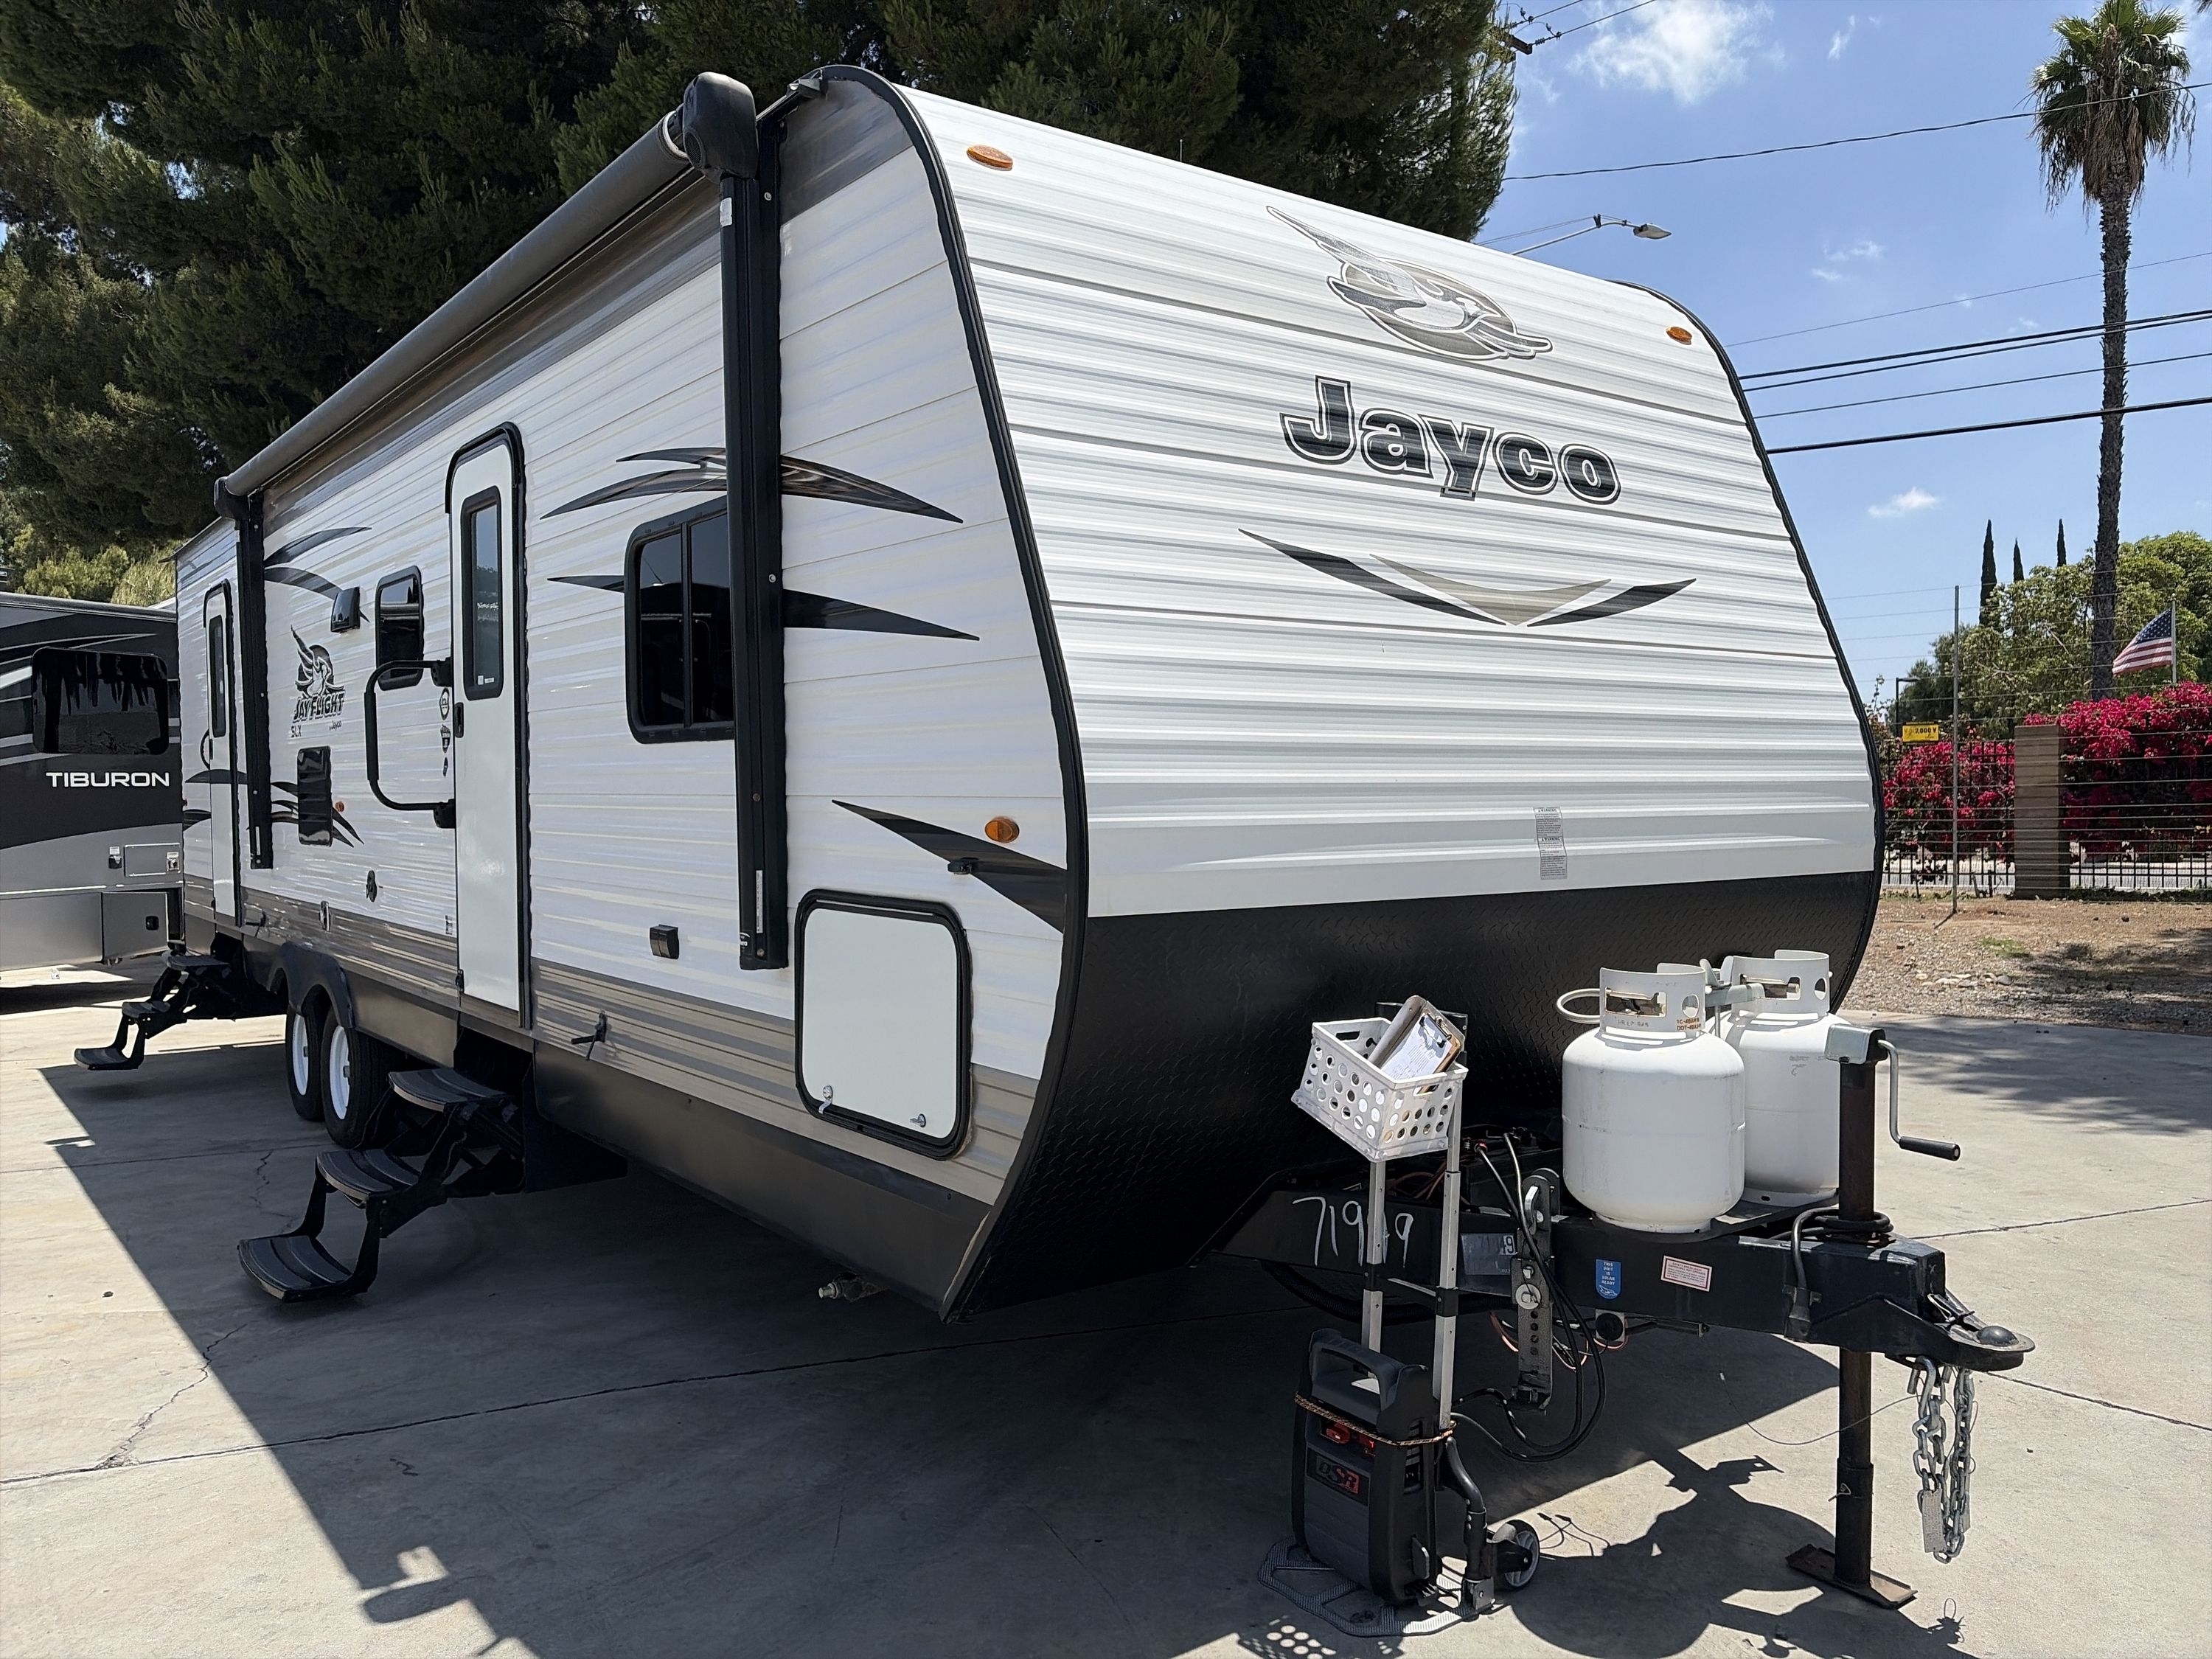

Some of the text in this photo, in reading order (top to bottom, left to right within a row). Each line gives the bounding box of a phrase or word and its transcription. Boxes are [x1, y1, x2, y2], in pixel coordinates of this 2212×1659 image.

[1279, 375, 1621, 505] Jayco
[293, 691, 345, 723] JAY FLIGHT
[46, 772, 170, 787] TIBURON
